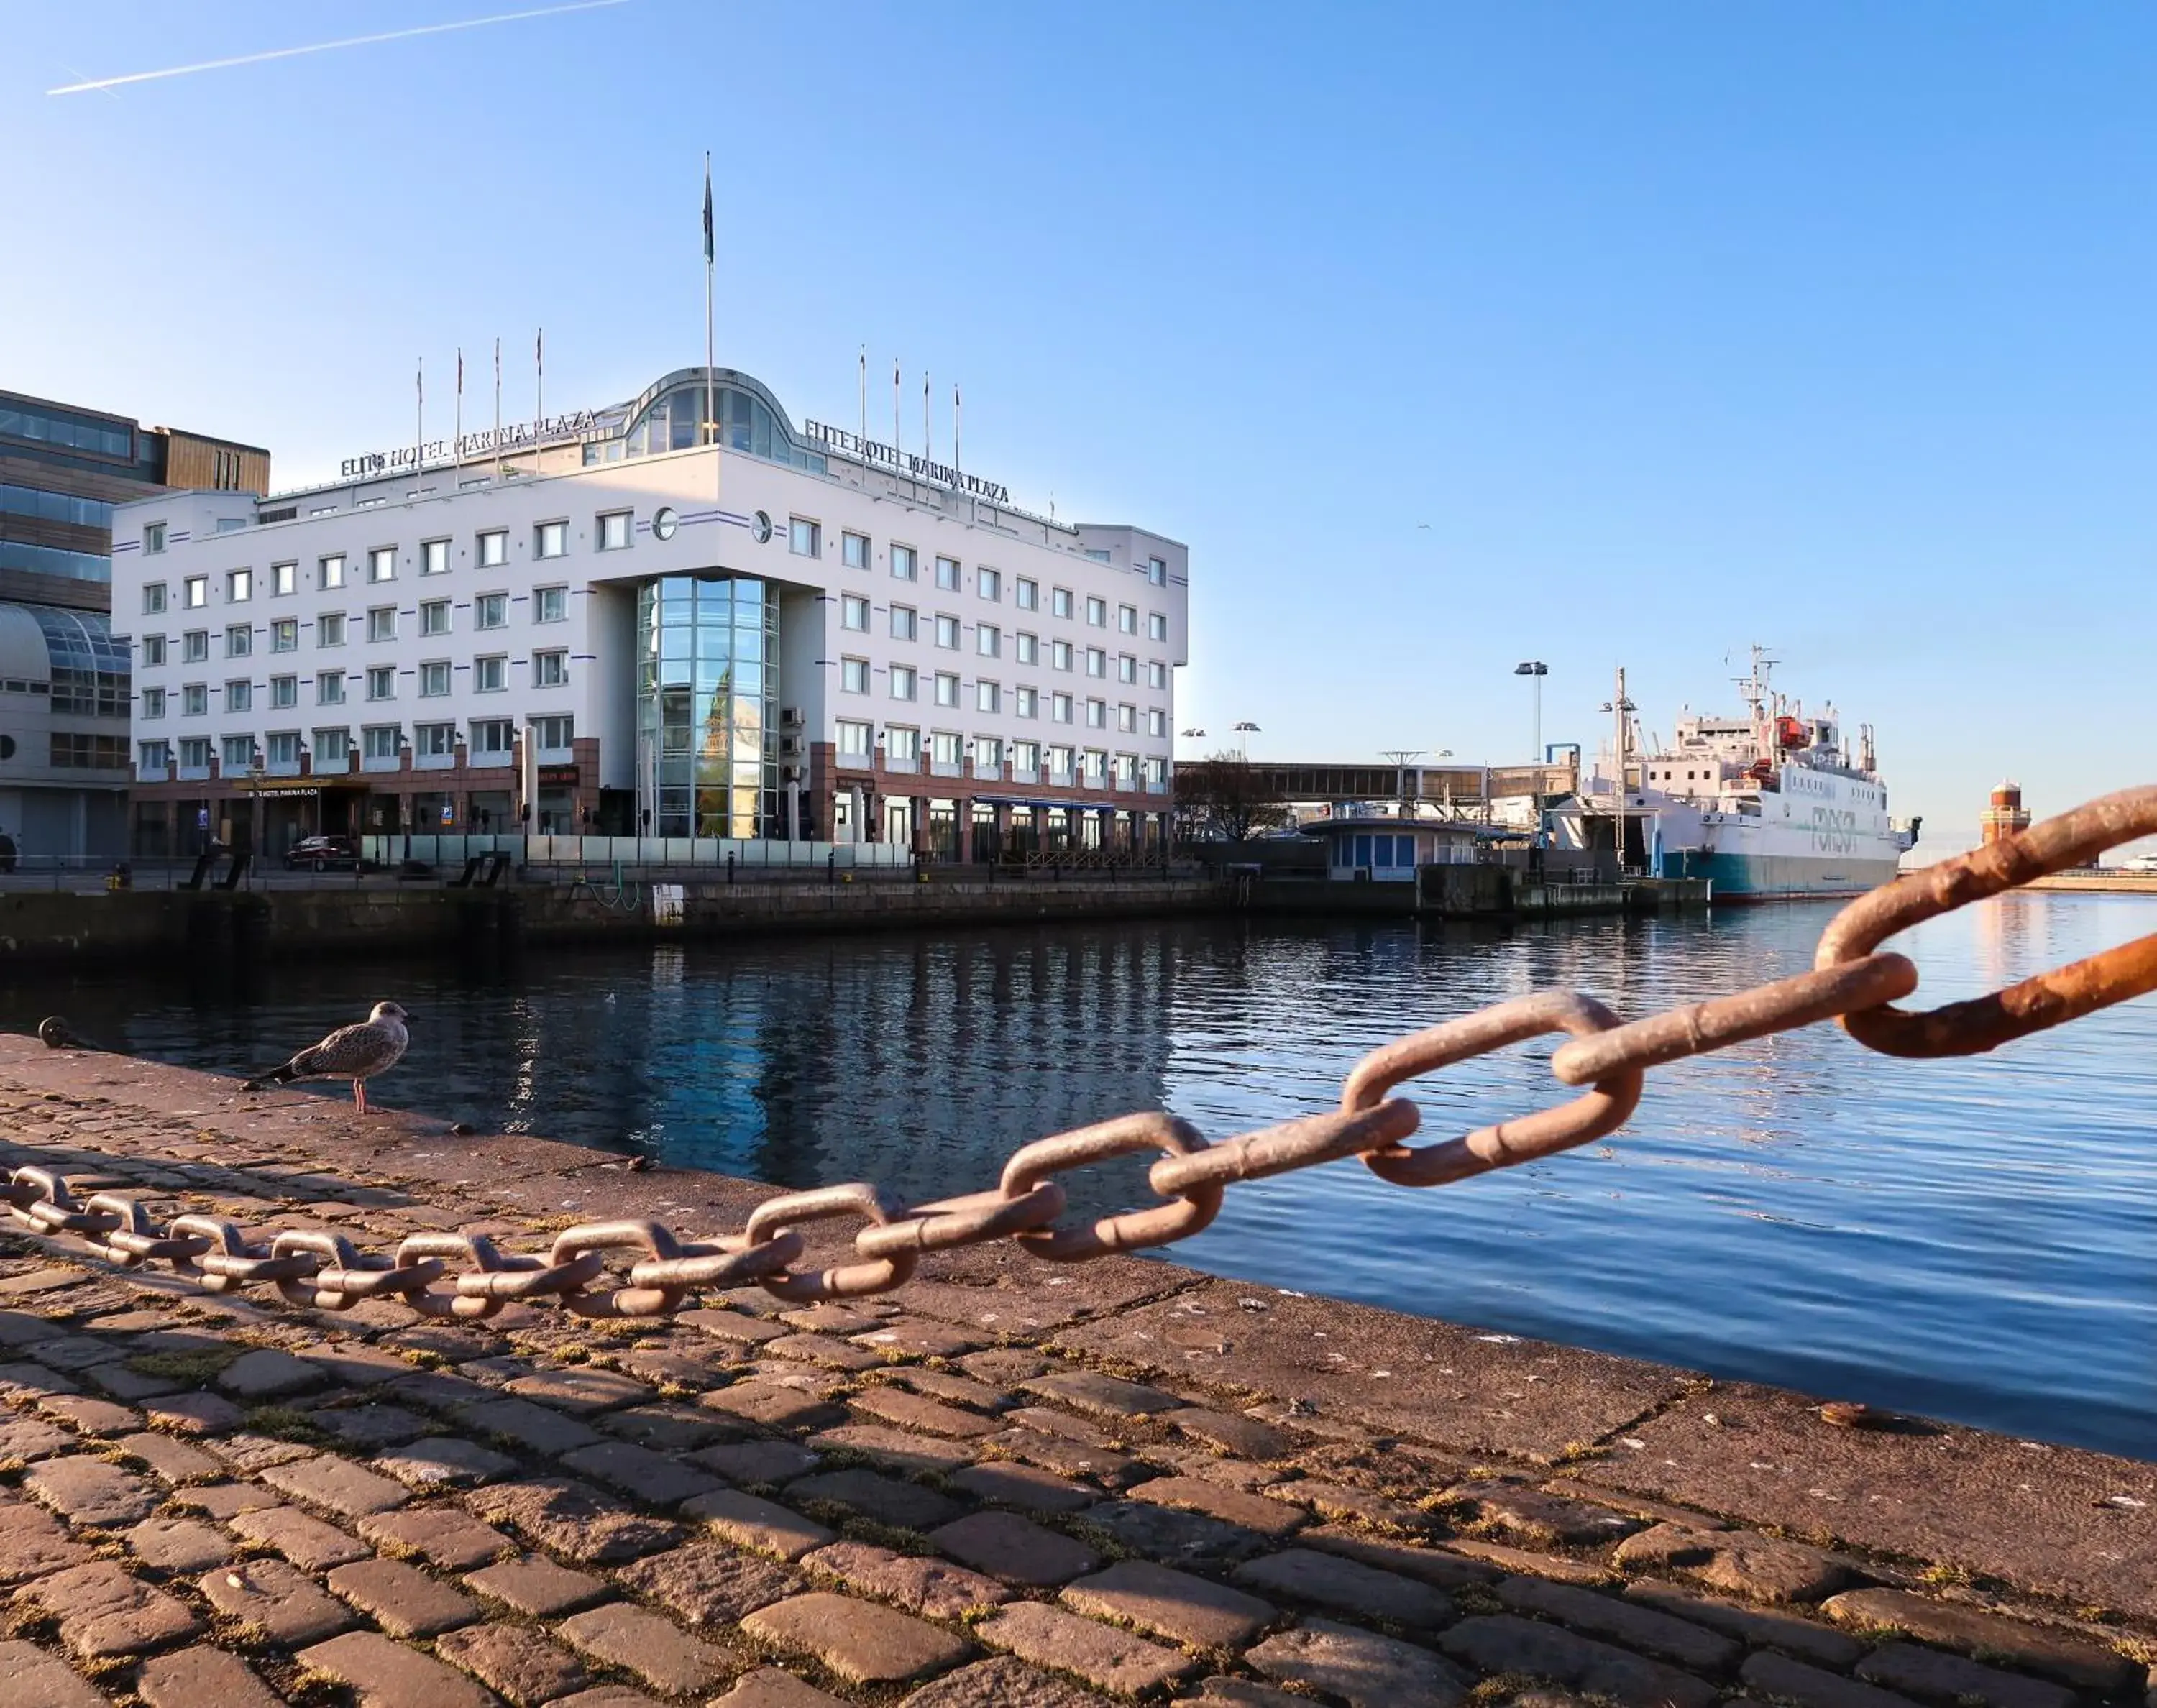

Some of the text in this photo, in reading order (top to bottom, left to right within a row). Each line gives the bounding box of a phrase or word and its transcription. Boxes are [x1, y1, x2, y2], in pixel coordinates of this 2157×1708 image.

[390, 441, 447, 465] HOTEL
[454, 423, 527, 453] MARINA
[534, 409, 597, 437] PLAZA
[909, 454, 964, 489] MARINA
[968, 475, 1009, 503] PLAZA
